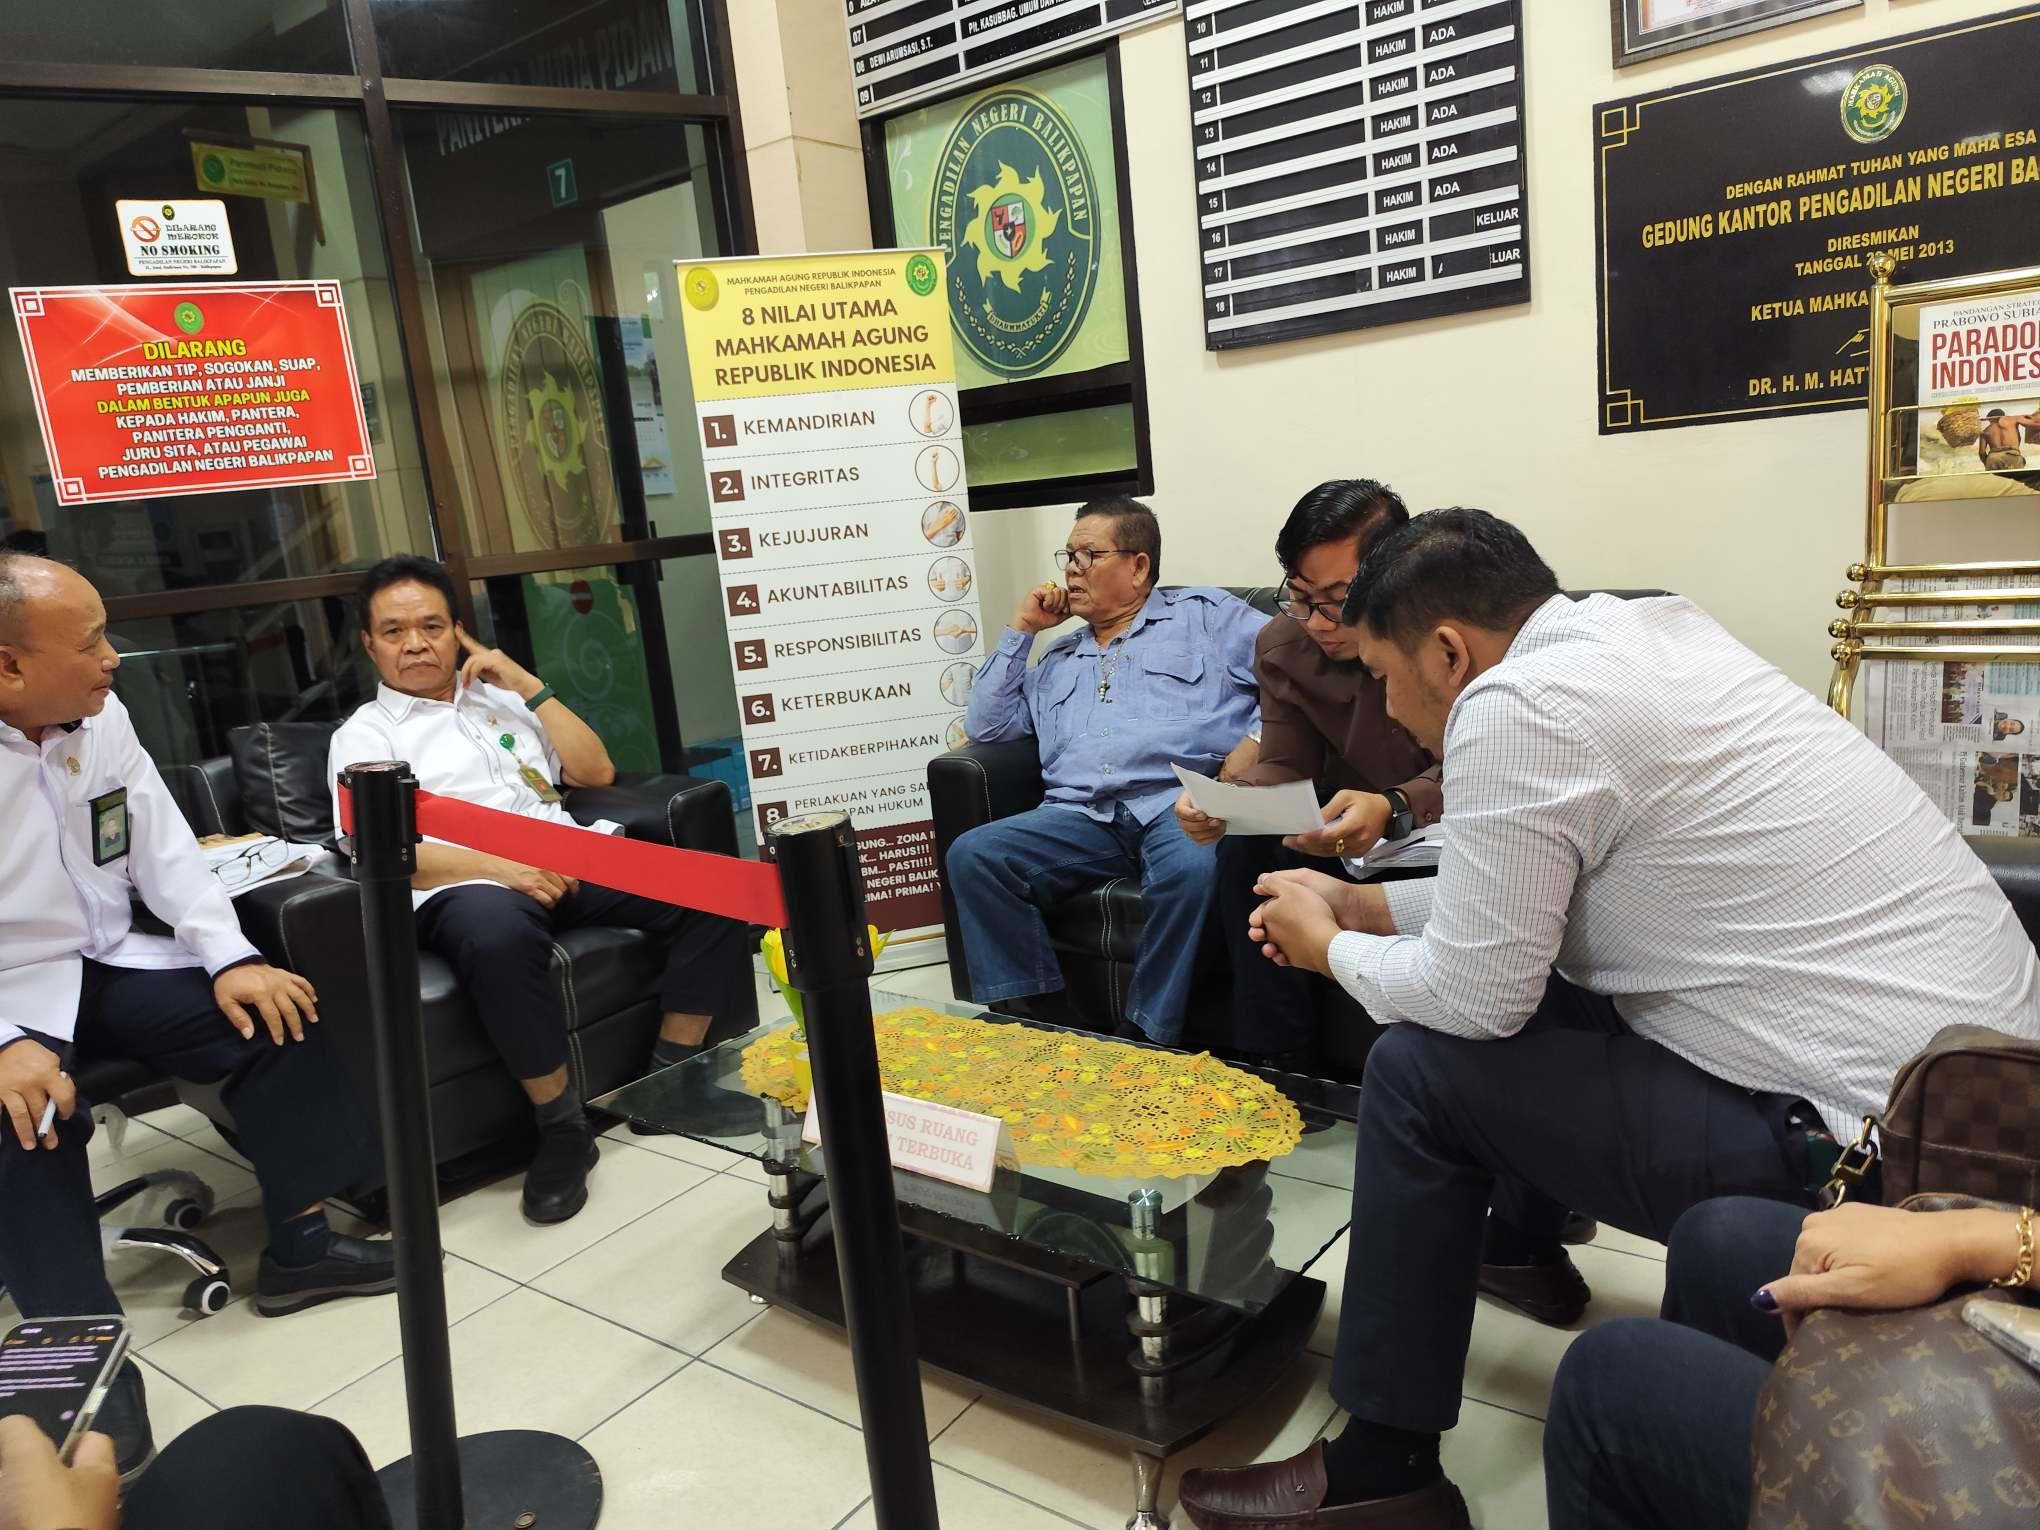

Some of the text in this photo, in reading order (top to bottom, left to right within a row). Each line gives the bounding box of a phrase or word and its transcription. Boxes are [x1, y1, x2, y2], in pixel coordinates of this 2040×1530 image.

[852, 30, 862, 44] 07
[856, 60, 865, 74] 08
[869, 54, 886, 69] DEWI
[921, 37, 934, 50] S.T.
[980, 9, 1018, 32] KASUBBAG.
[1019, 1, 1040, 17] UMUM
[1196, 22, 1206, 34] 10
[1200, 2, 1406, 70] 11 HAKIM
[1201, 26, 1456, 104] 12 HAKIM ADA
[859, 91, 870, 103] 09
[1204, 65, 1456, 139] 13 HAKIM ADA
[1206, 104, 1458, 174] 14 HAKIM ADA
[939, 103, 1088, 253] PENGADILAN NEGERI BALIKPAPAN
[1208, 143, 1459, 209] 15 HAKIM ADA
[1726, 129, 2037, 200] DENGAN RAHMAT TUHAN YANG MAHA ESA
[554, 167, 566, 199] 7
[1211, 181, 1461, 244] 16 HAKIM ADA
[1642, 214, 1713, 248] GEDUNG
[1718, 200, 1792, 234] KANTOR
[1799, 178, 1921, 221] PENGADILAN
[1927, 161, 2004, 199] NEGERI
[165, 224, 217, 232] DILARANG
[1828, 225, 1919, 253] DIRESMIKAN
[140, 244, 220, 256] NO SMOKING
[1213, 208, 1519, 278] 17 HAKIM KELUAR
[1795, 255, 1862, 277] TANGGAL
[1887, 245, 1914, 262] MEI
[1919, 239, 1954, 259] 2013
[727, 268, 896, 286] MAHKAMAH AGUNG REPUBLIK INDONESIA
[744, 280, 882, 296] PENGADILAN NEGERI BALIKPAPAN
[1215, 248, 1521, 313] 18 HAKIM LUAR
[742, 298, 897, 326] 8 NILAI UTAMA
[1751, 301, 1805, 322] KETUA
[1933, 313, 1999, 329] PRABOWO
[1954, 305, 2004, 317] PANDANGAN
[143, 339, 246, 360] DILARANG
[715, 325, 929, 357] MAHKAMAH AGUNG
[1932, 320, 2040, 360] PARADO
[71, 358, 321, 382] MEMBERIKAN TIP, SOGOKAN, SUAP,
[715, 352, 936, 386] REPUBLIK INDONESIA
[1749, 365, 1869, 397] DR. H. M. HAT
[117, 375, 286, 396] PEMBERIAN ATAU JANJI
[97, 390, 310, 414] DALAM BENTUK APAPUN JUGA
[116, 406, 299, 429] KEPADA HAKIM, PANTERA,
[710, 411, 875, 440] 1. KEMANDIRIAN
[133, 422, 291, 443] PANITERA PENGGANTI,
[122, 436, 307, 461] JURU SITA, ATAU PEGAWAI
[98, 450, 333, 479] PENGADILAN NEGERI BALIKPAPAN
[719, 466, 860, 495] 2. INTEGRITAS
[728, 523, 868, 552] 3. KEJUJURAN
[736, 575, 909, 608] 4. AKUNTABILITAS
[743, 628, 921, 664] 5. RESPONSIBILITAS
[751, 683, 912, 717] 6. KETERBUKAAN
[758, 733, 939, 771] 7. KETIDAKBERPIHAKAN
[795, 790, 867, 810] PERLAKUAN
[872, 785, 906, 798] YANG
[878, 797, 924, 813] HUKUM
[879, 843, 930, 861] HARUS!!!
[896, 831, 928, 845] ZONA
[888, 856, 933, 872] PASTI!!!
[866, 874, 906, 889] NEGERI
[895, 882, 934, 898] PRIMA!
[920, 1119, 977, 1146] RUANG
[897, 1136, 973, 1170] TERBUKA
